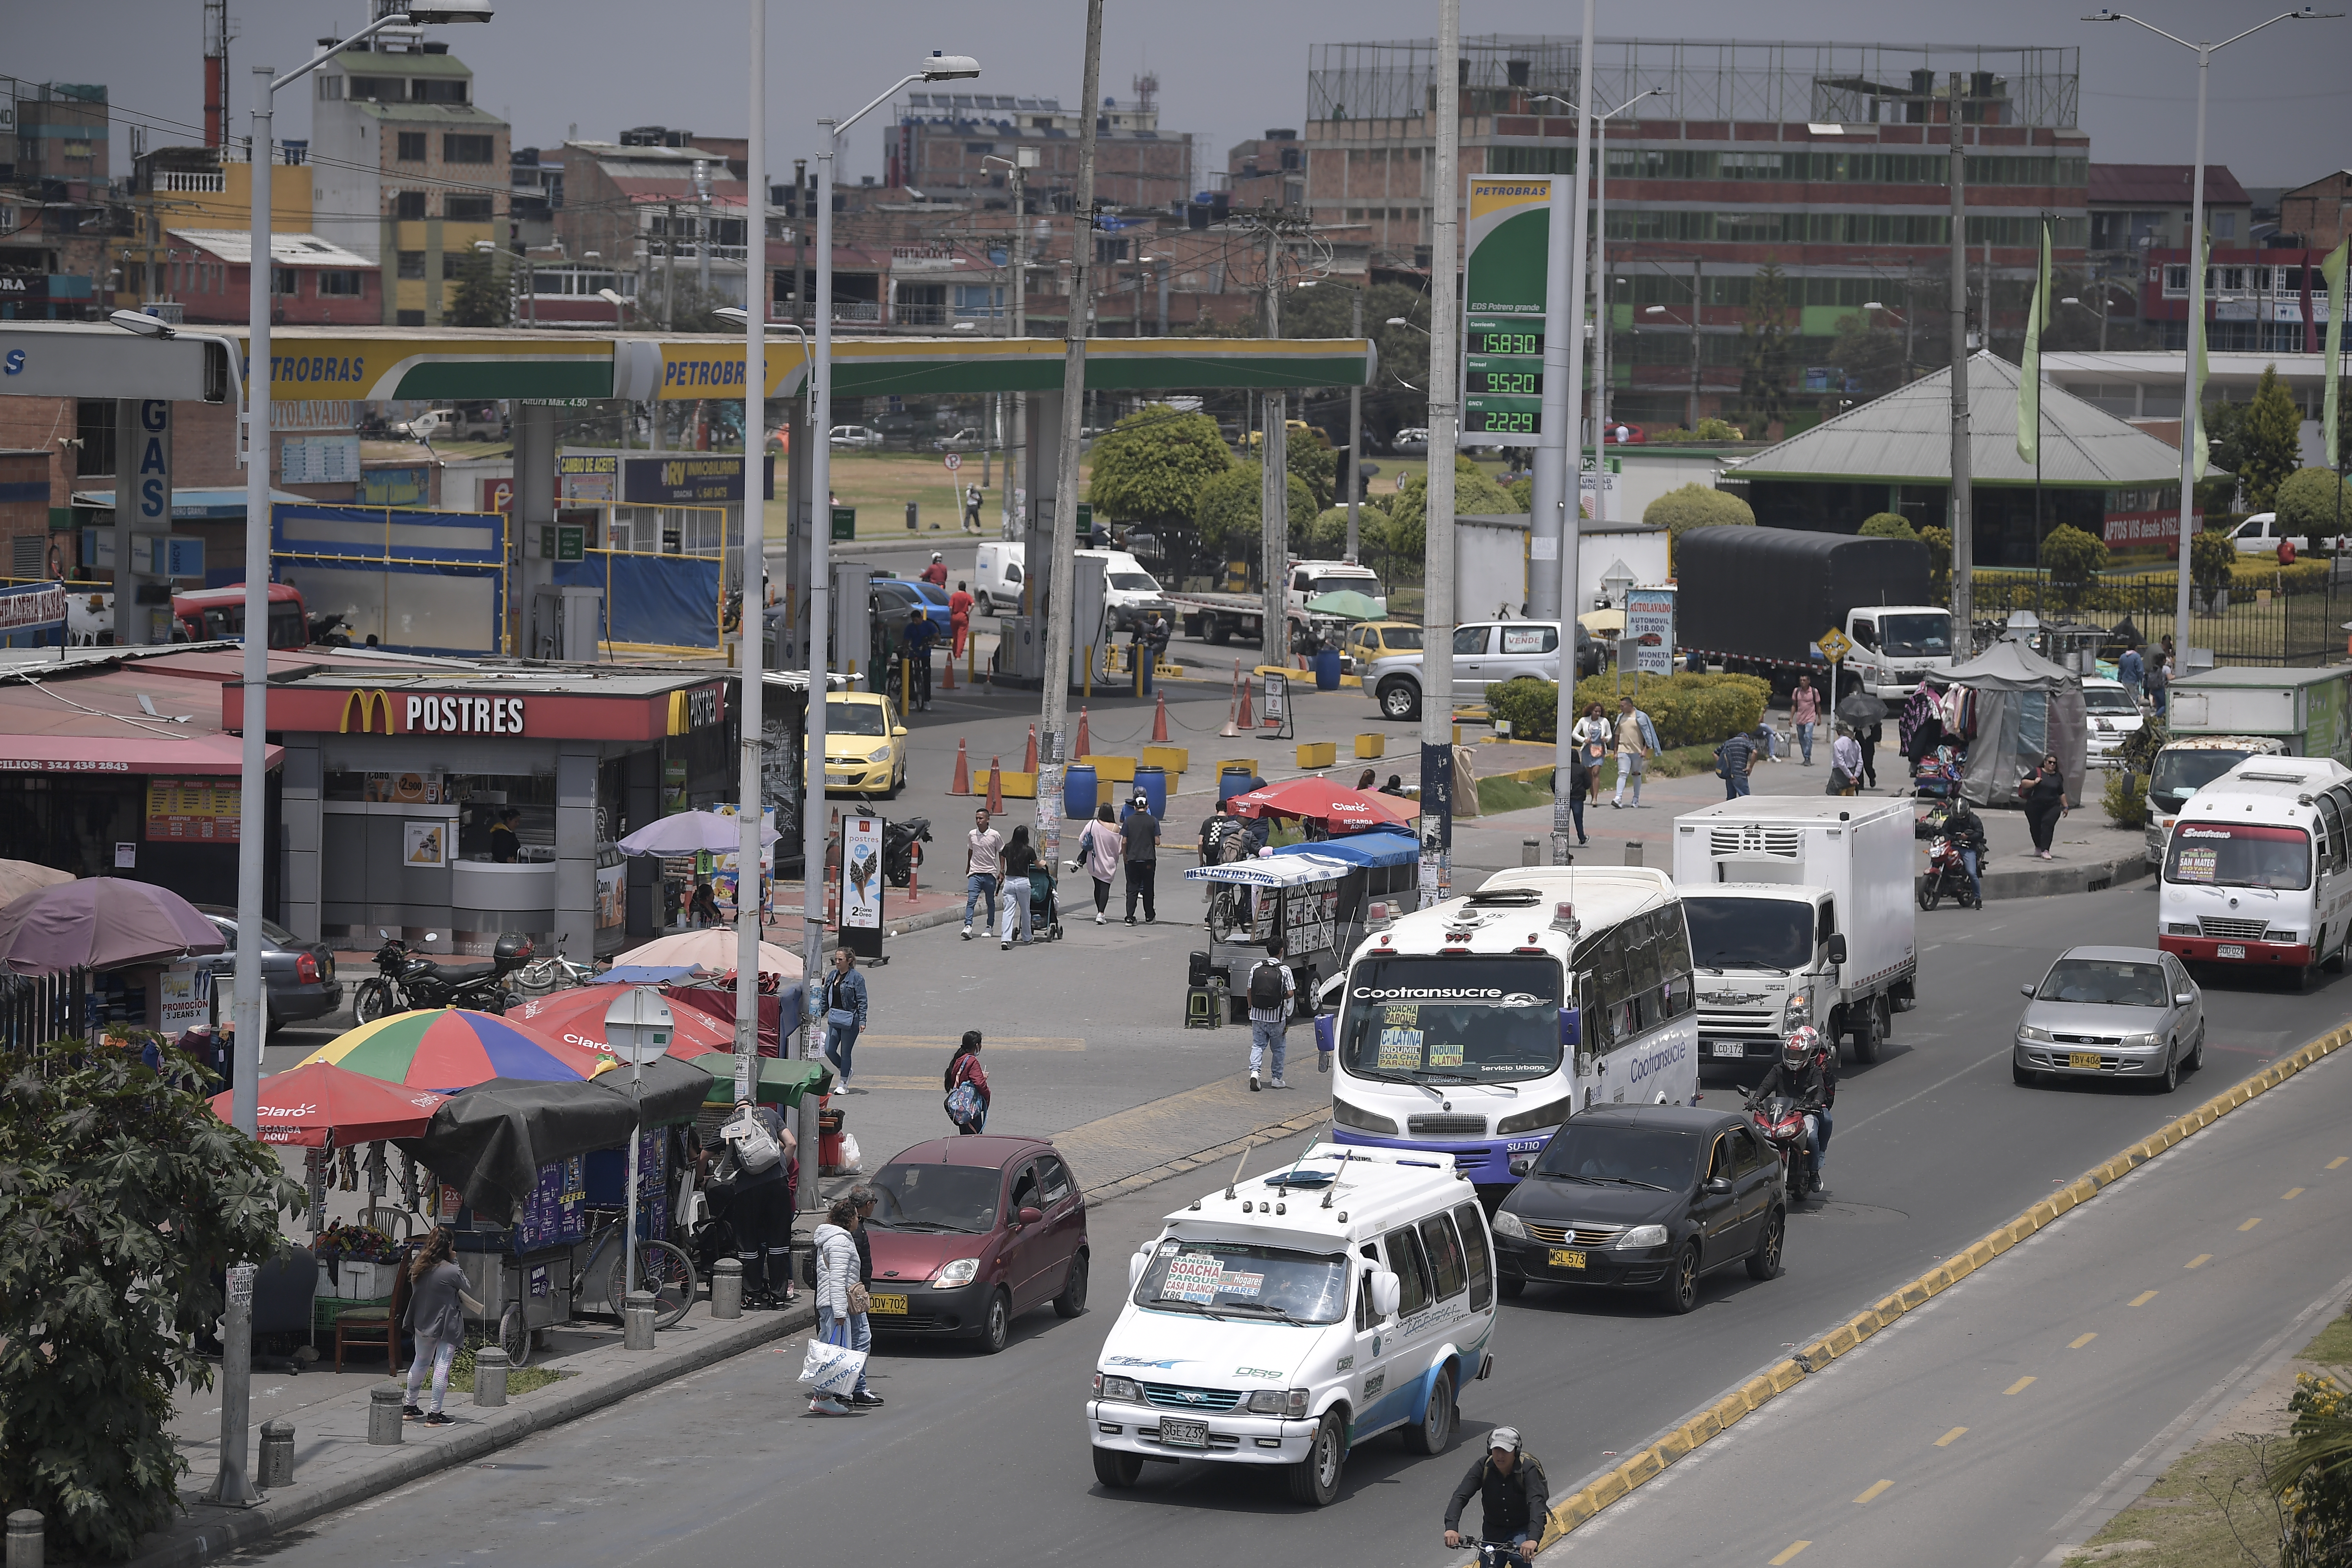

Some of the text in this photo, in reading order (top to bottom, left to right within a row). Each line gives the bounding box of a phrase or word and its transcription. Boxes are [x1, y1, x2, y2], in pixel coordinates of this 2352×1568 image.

[1475, 186, 1546, 196] PETROBRAS
[1472, 302, 1540, 313] EDS Potrero grande
[1483, 333, 1536, 354] 15.830
[1487, 373, 1535, 393] 9.520
[569, 399, 588, 407] 4.50
[1485, 412, 1533, 433] 2.229
[140, 399, 167, 517] GAS
[561, 457, 615, 473] CAMBIO DE ACEITE
[669, 461, 686, 485] RV
[2105, 518, 2160, 541] APTOS VIS desde
[172, 544, 180, 572] GNCV
[1630, 603, 1671, 613] AUTOLAVADO
[406, 695, 524, 733] POSTRES
[690, 688, 716, 727] POSTRES
[0, 760, 129, 771] ILIOS: 324 438 2843
[1332, 801, 1361, 811] Claro
[2180, 858, 2215, 867] SAN MATEO
[1186, 869, 1275, 885] NEW GAFAS YORK
[1296, 870, 1331, 884] NEW YORK
[596, 879, 611, 894] Cono
[1440, 887, 1450, 898] 255
[852, 906, 859, 917] 2
[1353, 986, 1503, 998] Cootransucre
[162, 998, 208, 1012] PROMOCIÓN
[1386, 1005, 1417, 1015] SOACHA
[172, 1011, 194, 1019] JEANS
[196, 1009, 201, 1017] X
[1385, 1013, 1416, 1024] PARQUE
[564, 1034, 614, 1052] Claro
[1392, 1031, 1421, 1046] LATINA
[1381, 1046, 1419, 1054] INDUMIL
[1431, 1046, 1462, 1055] INDUMIL
[1631, 1041, 1686, 1083] Cootransucre
[1590, 1084, 1602, 1101] SU-110
[257, 1103, 306, 1116] Claro
[258, 1125, 301, 1134] ECARGA
[263, 1133, 289, 1141] AQUI
[1506, 1141, 1540, 1151] SU-110
[1173, 1257, 1222, 1266] DANUBIO
[1549, 1251, 1585, 1265] MSL-573
[531, 1266, 545, 1280] WOM
[1171, 1262, 1220, 1278] SOACHA
[1167, 1273, 1219, 1285] PARQUE
[1233, 1274, 1263, 1287] Hogares
[1165, 1281, 1214, 1294] CASA BLANCA
[1217, 1285, 1259, 1296] TEJARES
[1162, 1290, 1211, 1303] K86 ROMA
[1405, 1304, 1461, 1338] MUNDIAL
[1337, 1354, 1354, 1371] 089
[1235, 1367, 1284, 1378] 089
[1163, 1424, 1205, 1439] SGE-239
